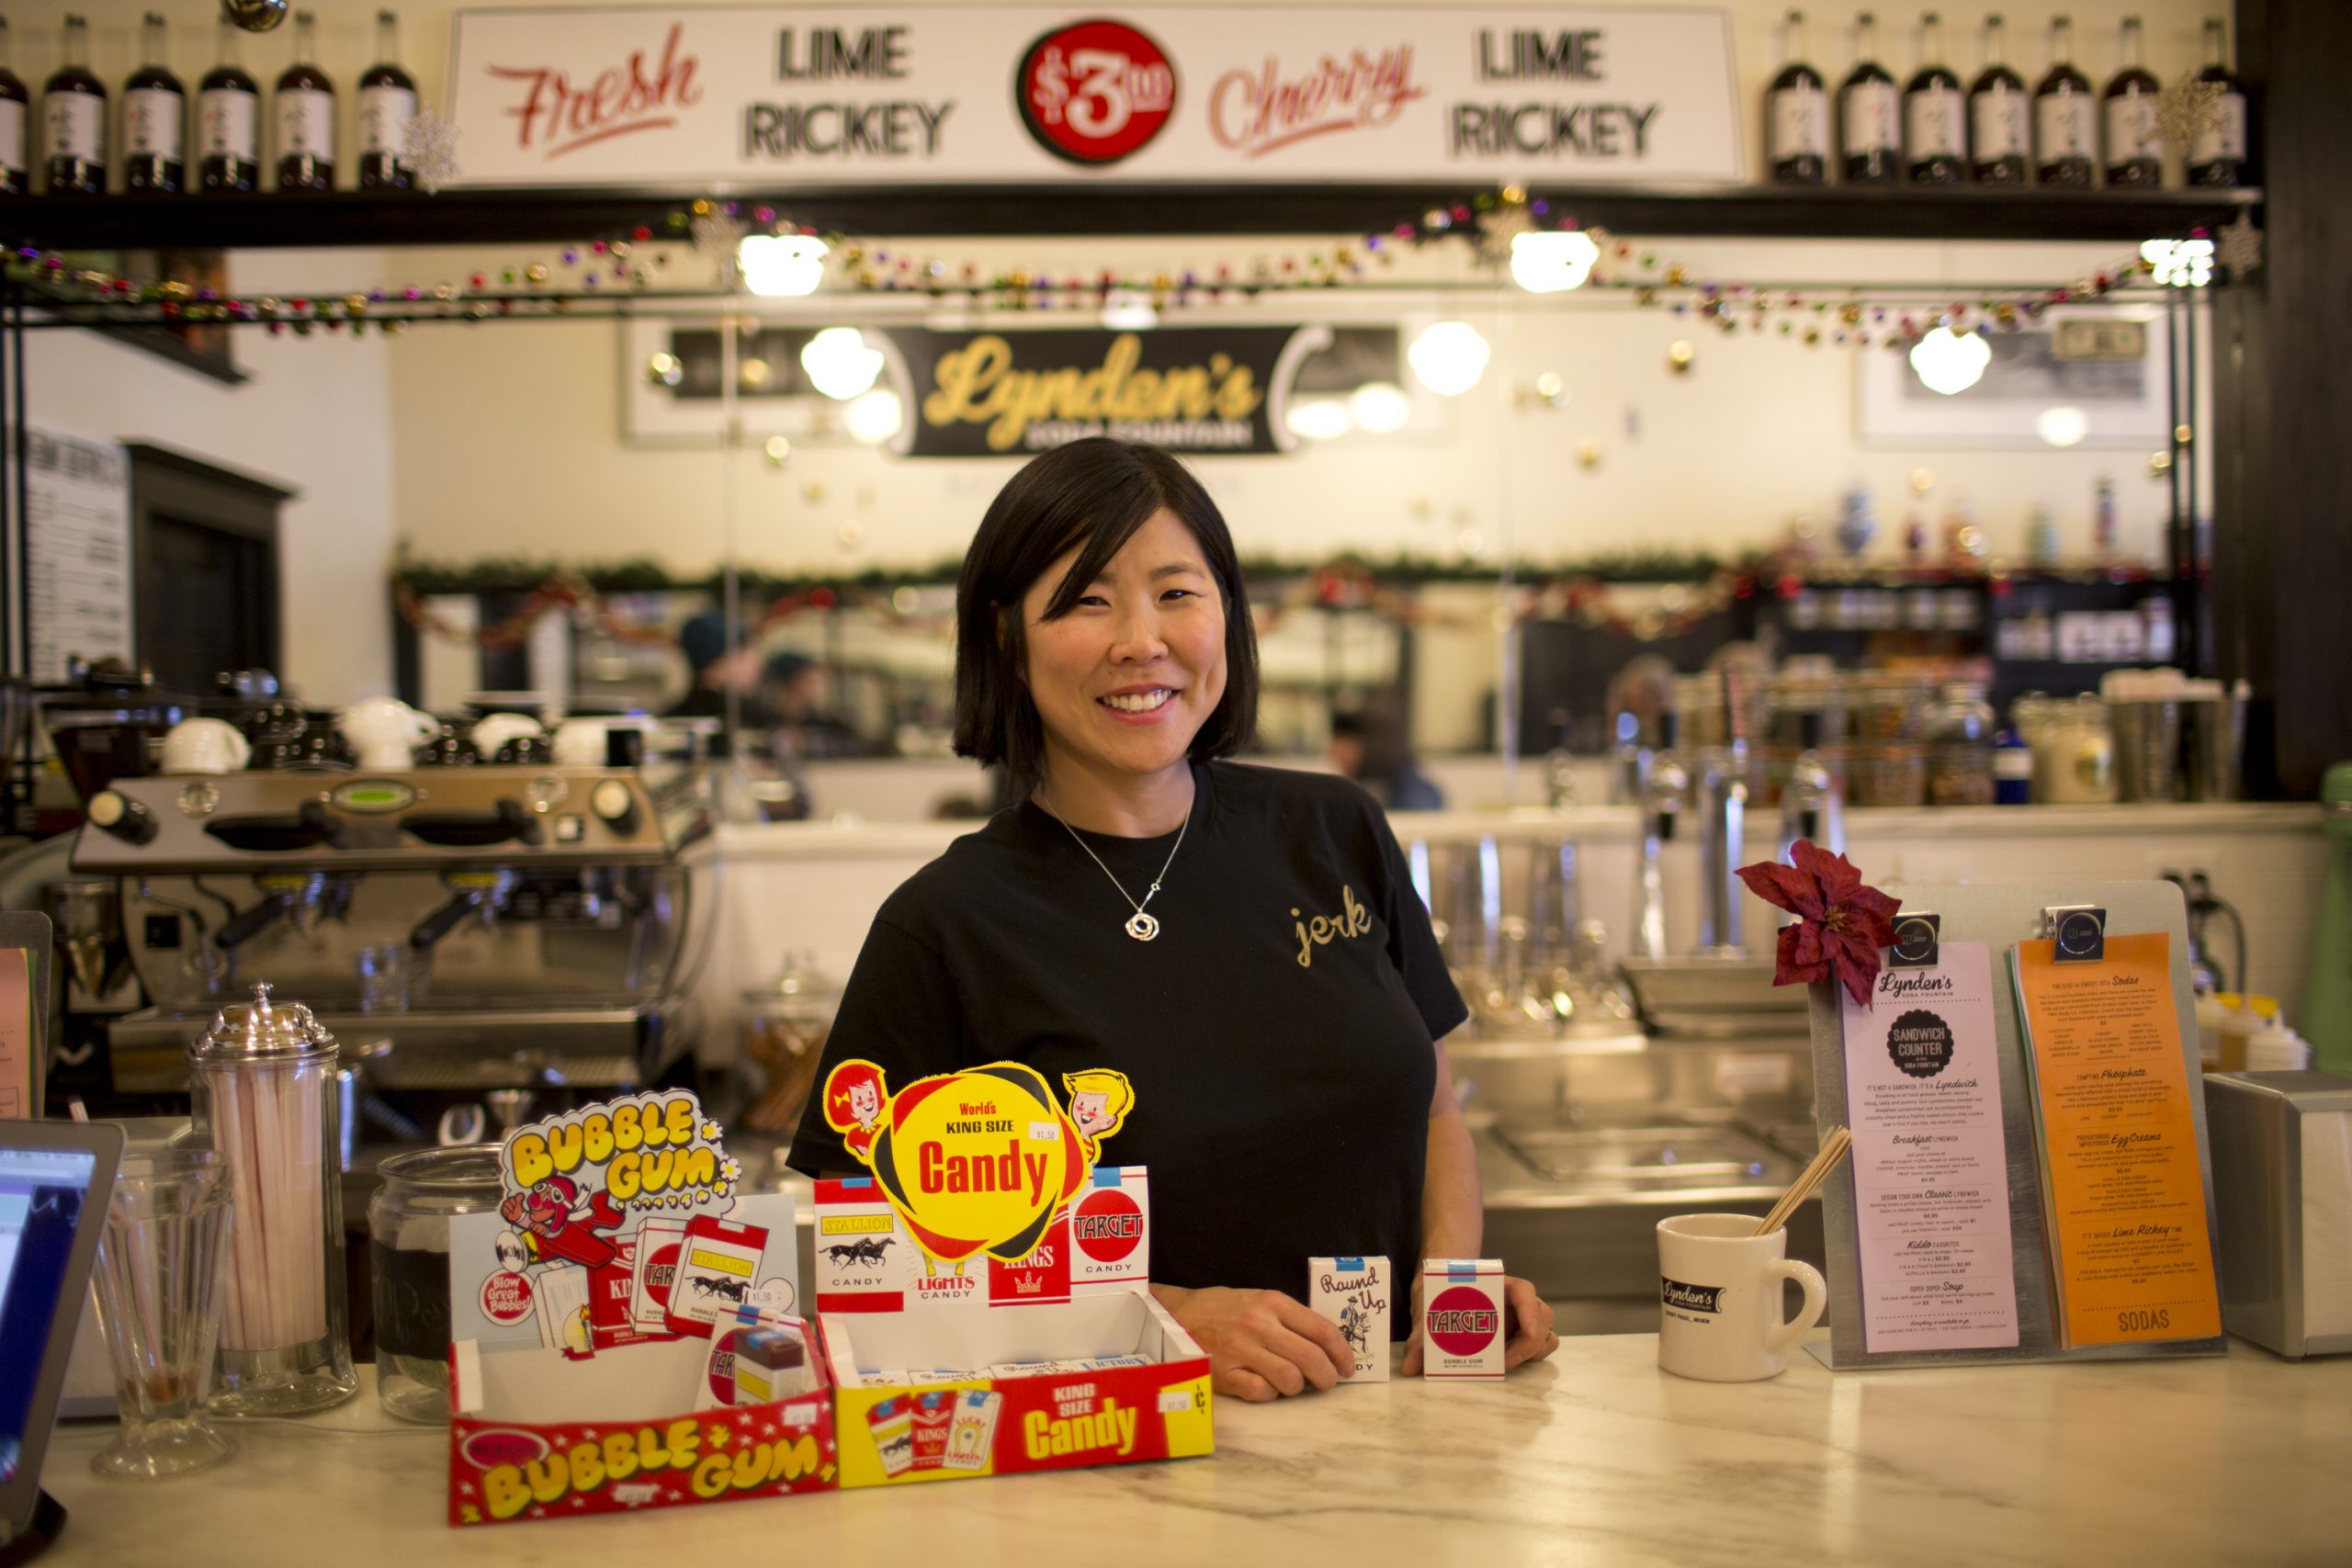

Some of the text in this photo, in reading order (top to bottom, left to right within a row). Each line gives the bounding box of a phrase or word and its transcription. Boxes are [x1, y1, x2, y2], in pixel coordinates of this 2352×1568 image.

[776, 26, 914, 81] LIME
[1476, 28, 1607, 81] LIME
[485, 22, 704, 150] Fresh
[1207, 43, 1430, 151] Cherry
[743, 102, 957, 157] RICKEY
[1448, 105, 1661, 158] RICKEY
[923, 333, 1263, 450] Lynden's
[1290, 885, 1372, 967] jerk
[1878, 971, 1953, 998] Lynden's
[2111, 976, 2139, 986] Sodas
[1893, 1027, 1945, 1042] SANDWICH
[1898, 1043, 1942, 1057] COUNTER
[1935, 1078, 1978, 1091] Lyndwich
[959, 1100, 997, 1116] World's
[946, 1120, 1014, 1134] KING SIZE
[1037, 1131, 1055, 1140] $1.50
[511, 1099, 695, 1188] BUBBLE
[1892, 1134, 1933, 1146] Breakfast
[2110, 1132, 2162, 1148] Egg Creams
[605, 1146, 716, 1200] GUM
[920, 1139, 1048, 1207] Candy
[1924, 1190, 1953, 1199] Classic
[825, 1218, 892, 1233] STALLION
[1074, 1214, 1144, 1240] TARGET
[2112, 1227, 2136, 1237] Lime
[2136, 1224, 2170, 1236] Rickey
[1906, 1240, 1932, 1249] Kiddo
[1086, 1264, 1132, 1273] CANDY
[492, 1276, 520, 1289] Blow
[832, 1278, 883, 1286] CANDY
[918, 1277, 976, 1291] LIGHTS
[1320, 1267, 1380, 1293] Round
[1941, 1281, 1964, 1294] Soup
[488, 1288, 520, 1300] Great
[922, 1291, 971, 1299] CANDY
[1357, 1290, 1386, 1314] Up
[1665, 1281, 1712, 1304] Lynden's
[490, 1294, 530, 1314] Bubbles!
[1427, 1310, 1498, 1333] TARGET
[2119, 1308, 2170, 1332] SODAS
[1053, 1382, 1096, 1402] KING
[1059, 1399, 1092, 1417] SIZE
[917, 1427, 947, 1441] KINGS
[1024, 1397, 1137, 1461] Candy
[483, 1420, 701, 1519] BUBBLE
[692, 1434, 819, 1500] GUM
